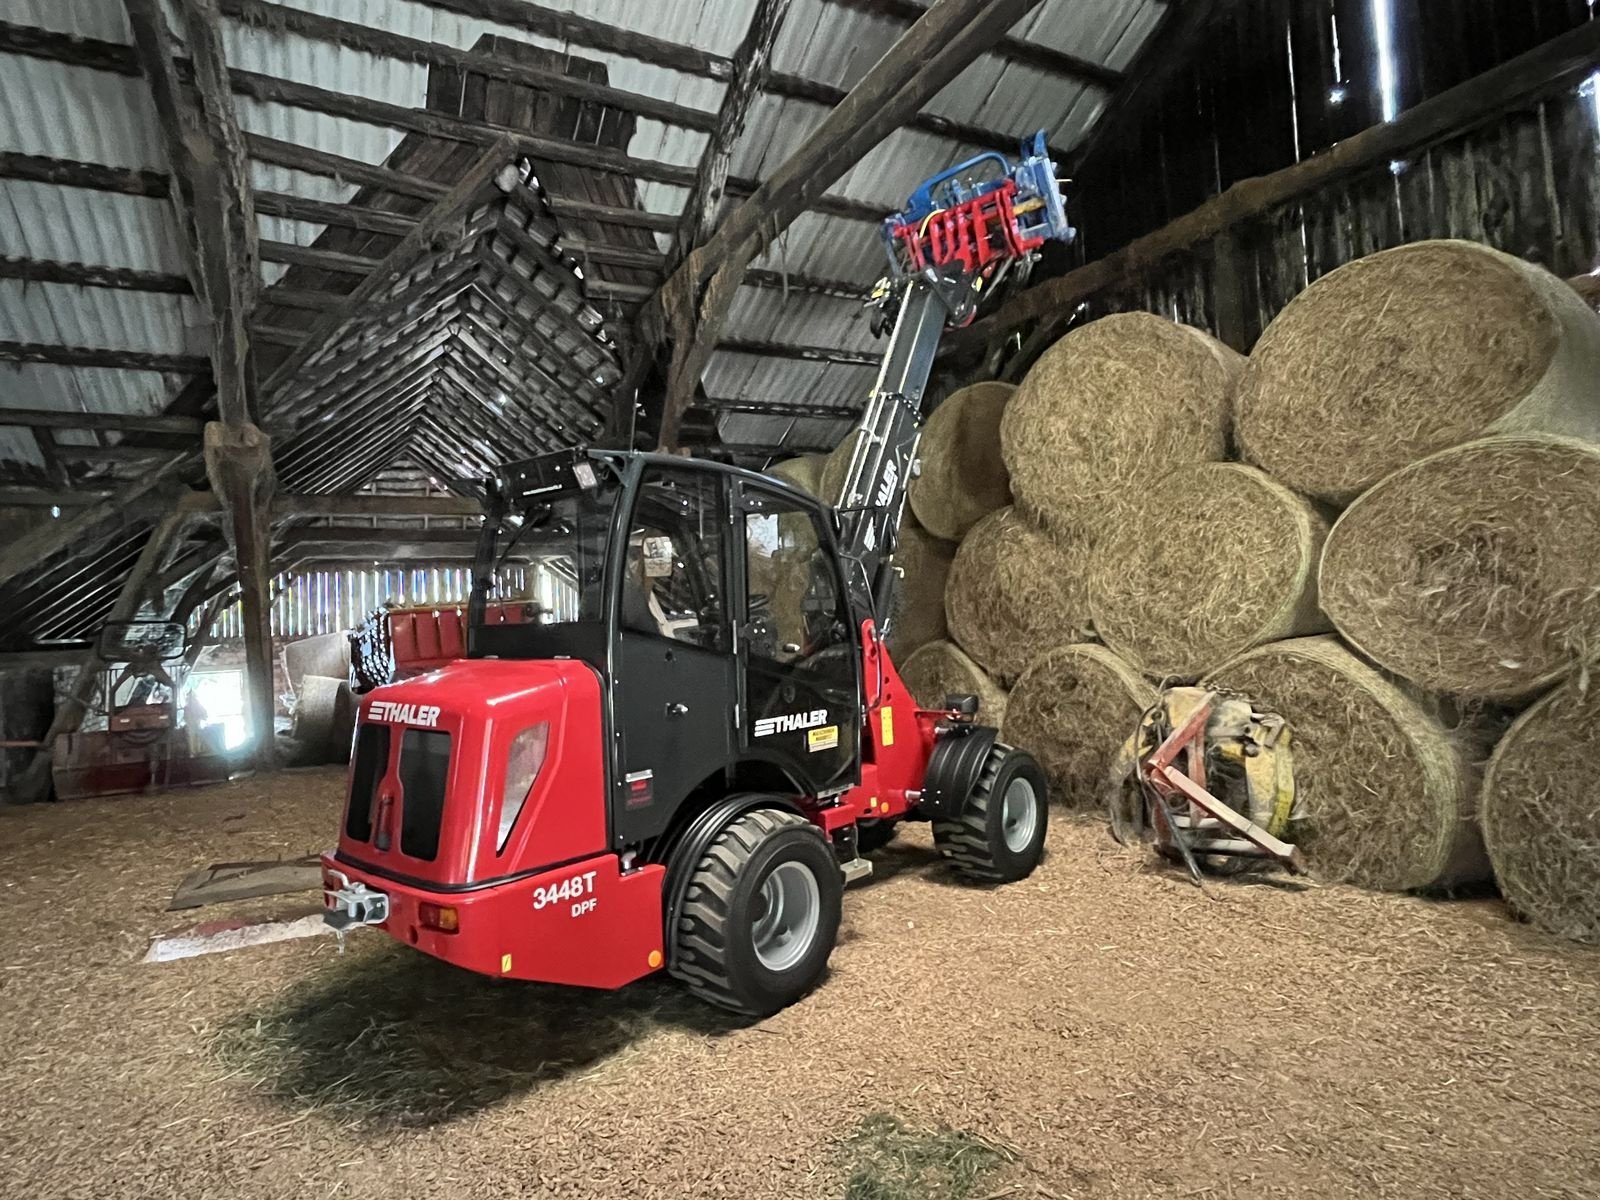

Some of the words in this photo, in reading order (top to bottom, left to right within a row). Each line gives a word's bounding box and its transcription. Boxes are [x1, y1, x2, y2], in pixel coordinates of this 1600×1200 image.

[372, 701, 441, 727] THALER
[763, 709, 828, 734] THALER
[533, 871, 597, 910] 3448T
[571, 898, 597, 918] DPF
